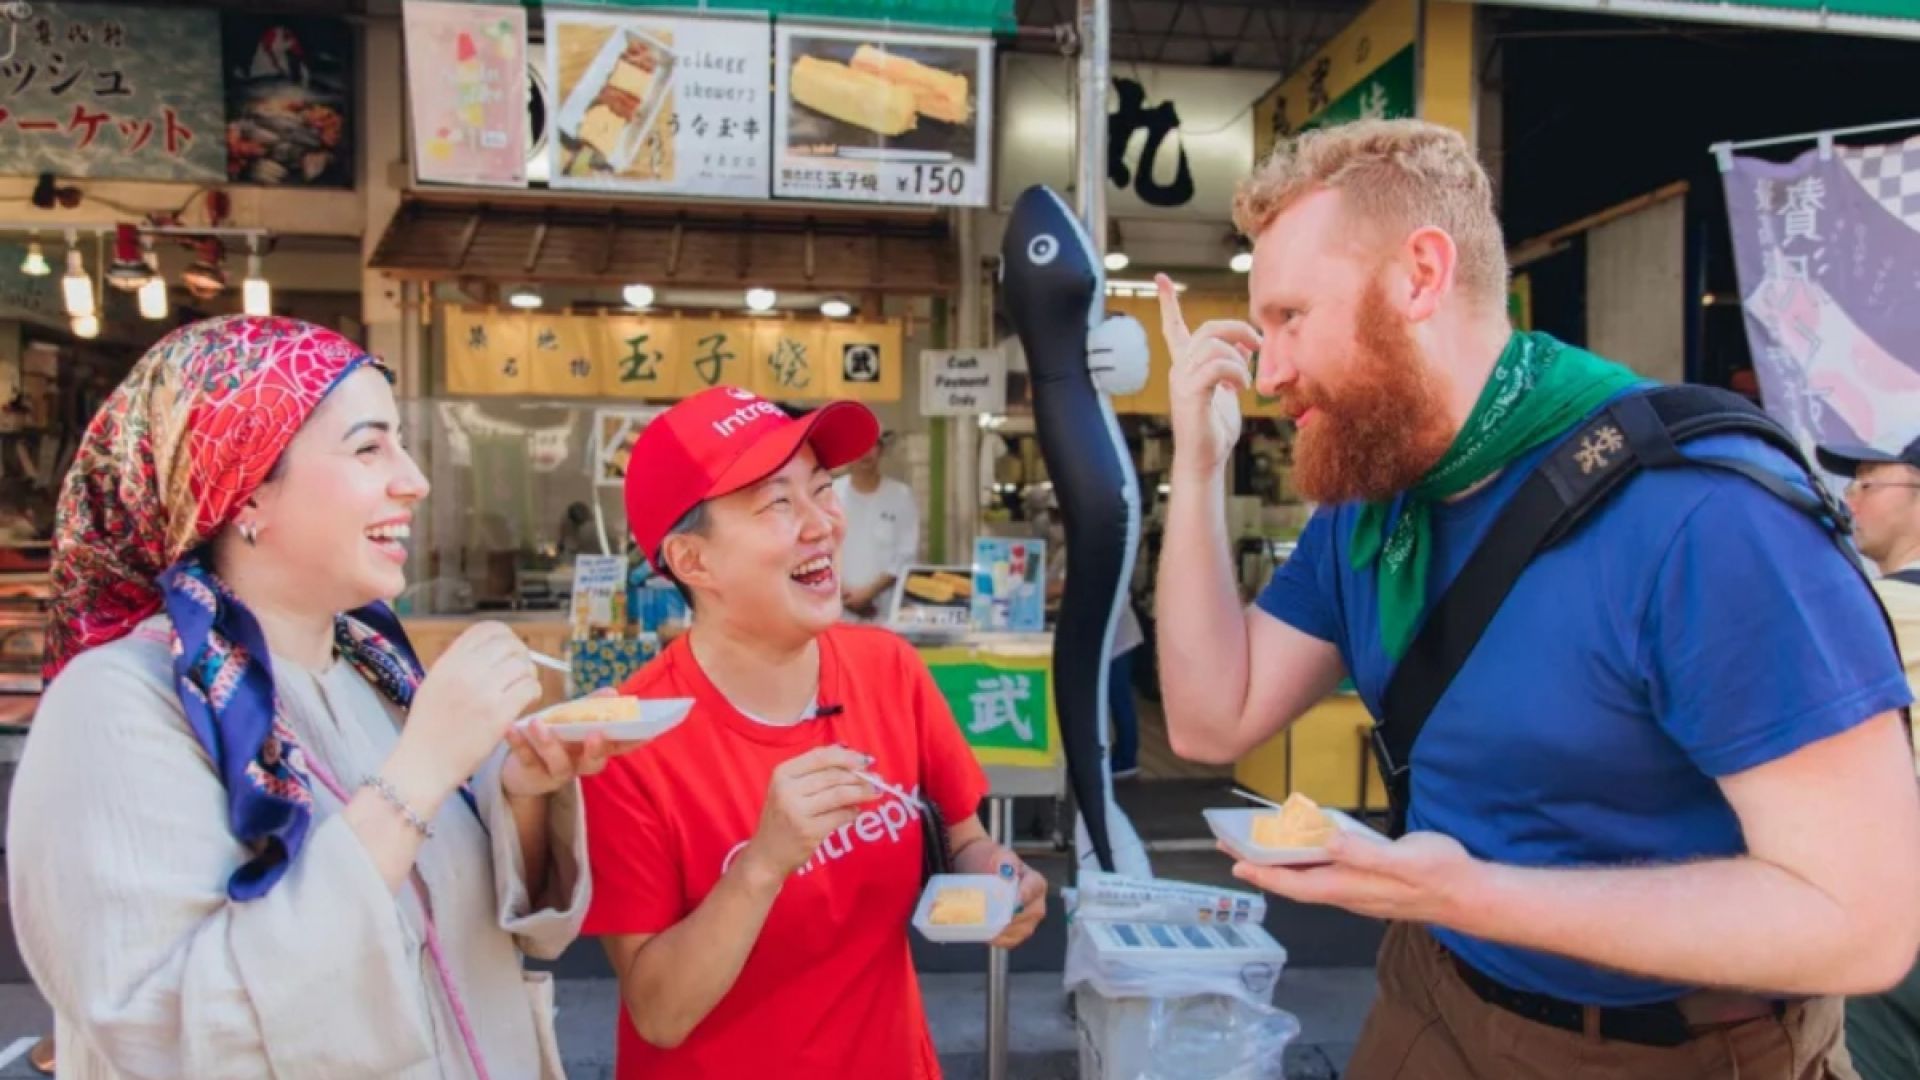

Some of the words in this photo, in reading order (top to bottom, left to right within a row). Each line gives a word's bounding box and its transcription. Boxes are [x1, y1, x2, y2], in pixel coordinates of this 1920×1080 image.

[0, 104, 192, 154] ーケット
[896, 164, 965, 196] ¥150
[946, 355, 978, 369] Cash
[935, 374, 989, 390] Payment
[967, 673, 1033, 741] 武
